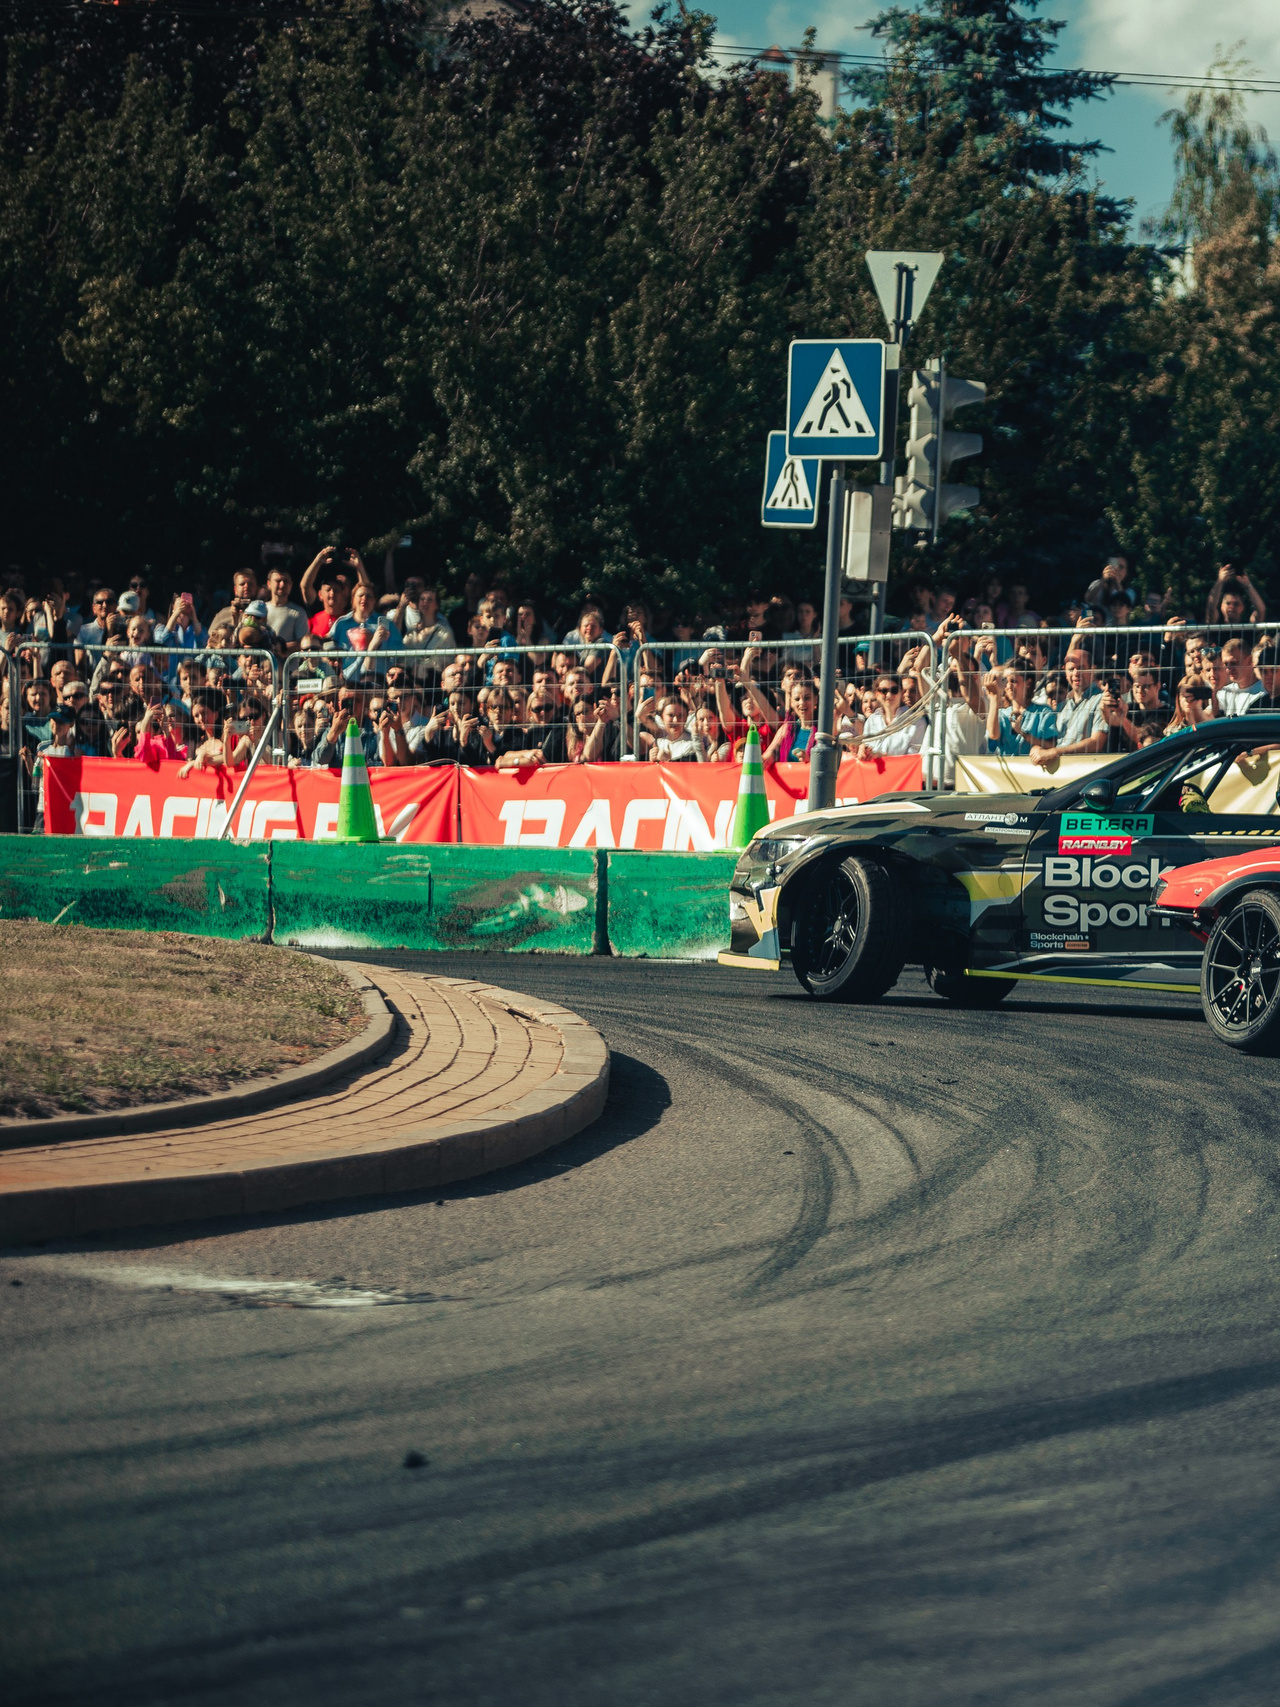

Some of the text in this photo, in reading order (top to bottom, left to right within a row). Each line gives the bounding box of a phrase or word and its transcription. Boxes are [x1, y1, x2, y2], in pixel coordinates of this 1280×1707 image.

[1066, 818, 1149, 831] BET.ERA
[1062, 839, 1128, 850] RACING.BY
[1030, 932, 1084, 940] Blockchain
[1030, 941, 1064, 949] Sports
